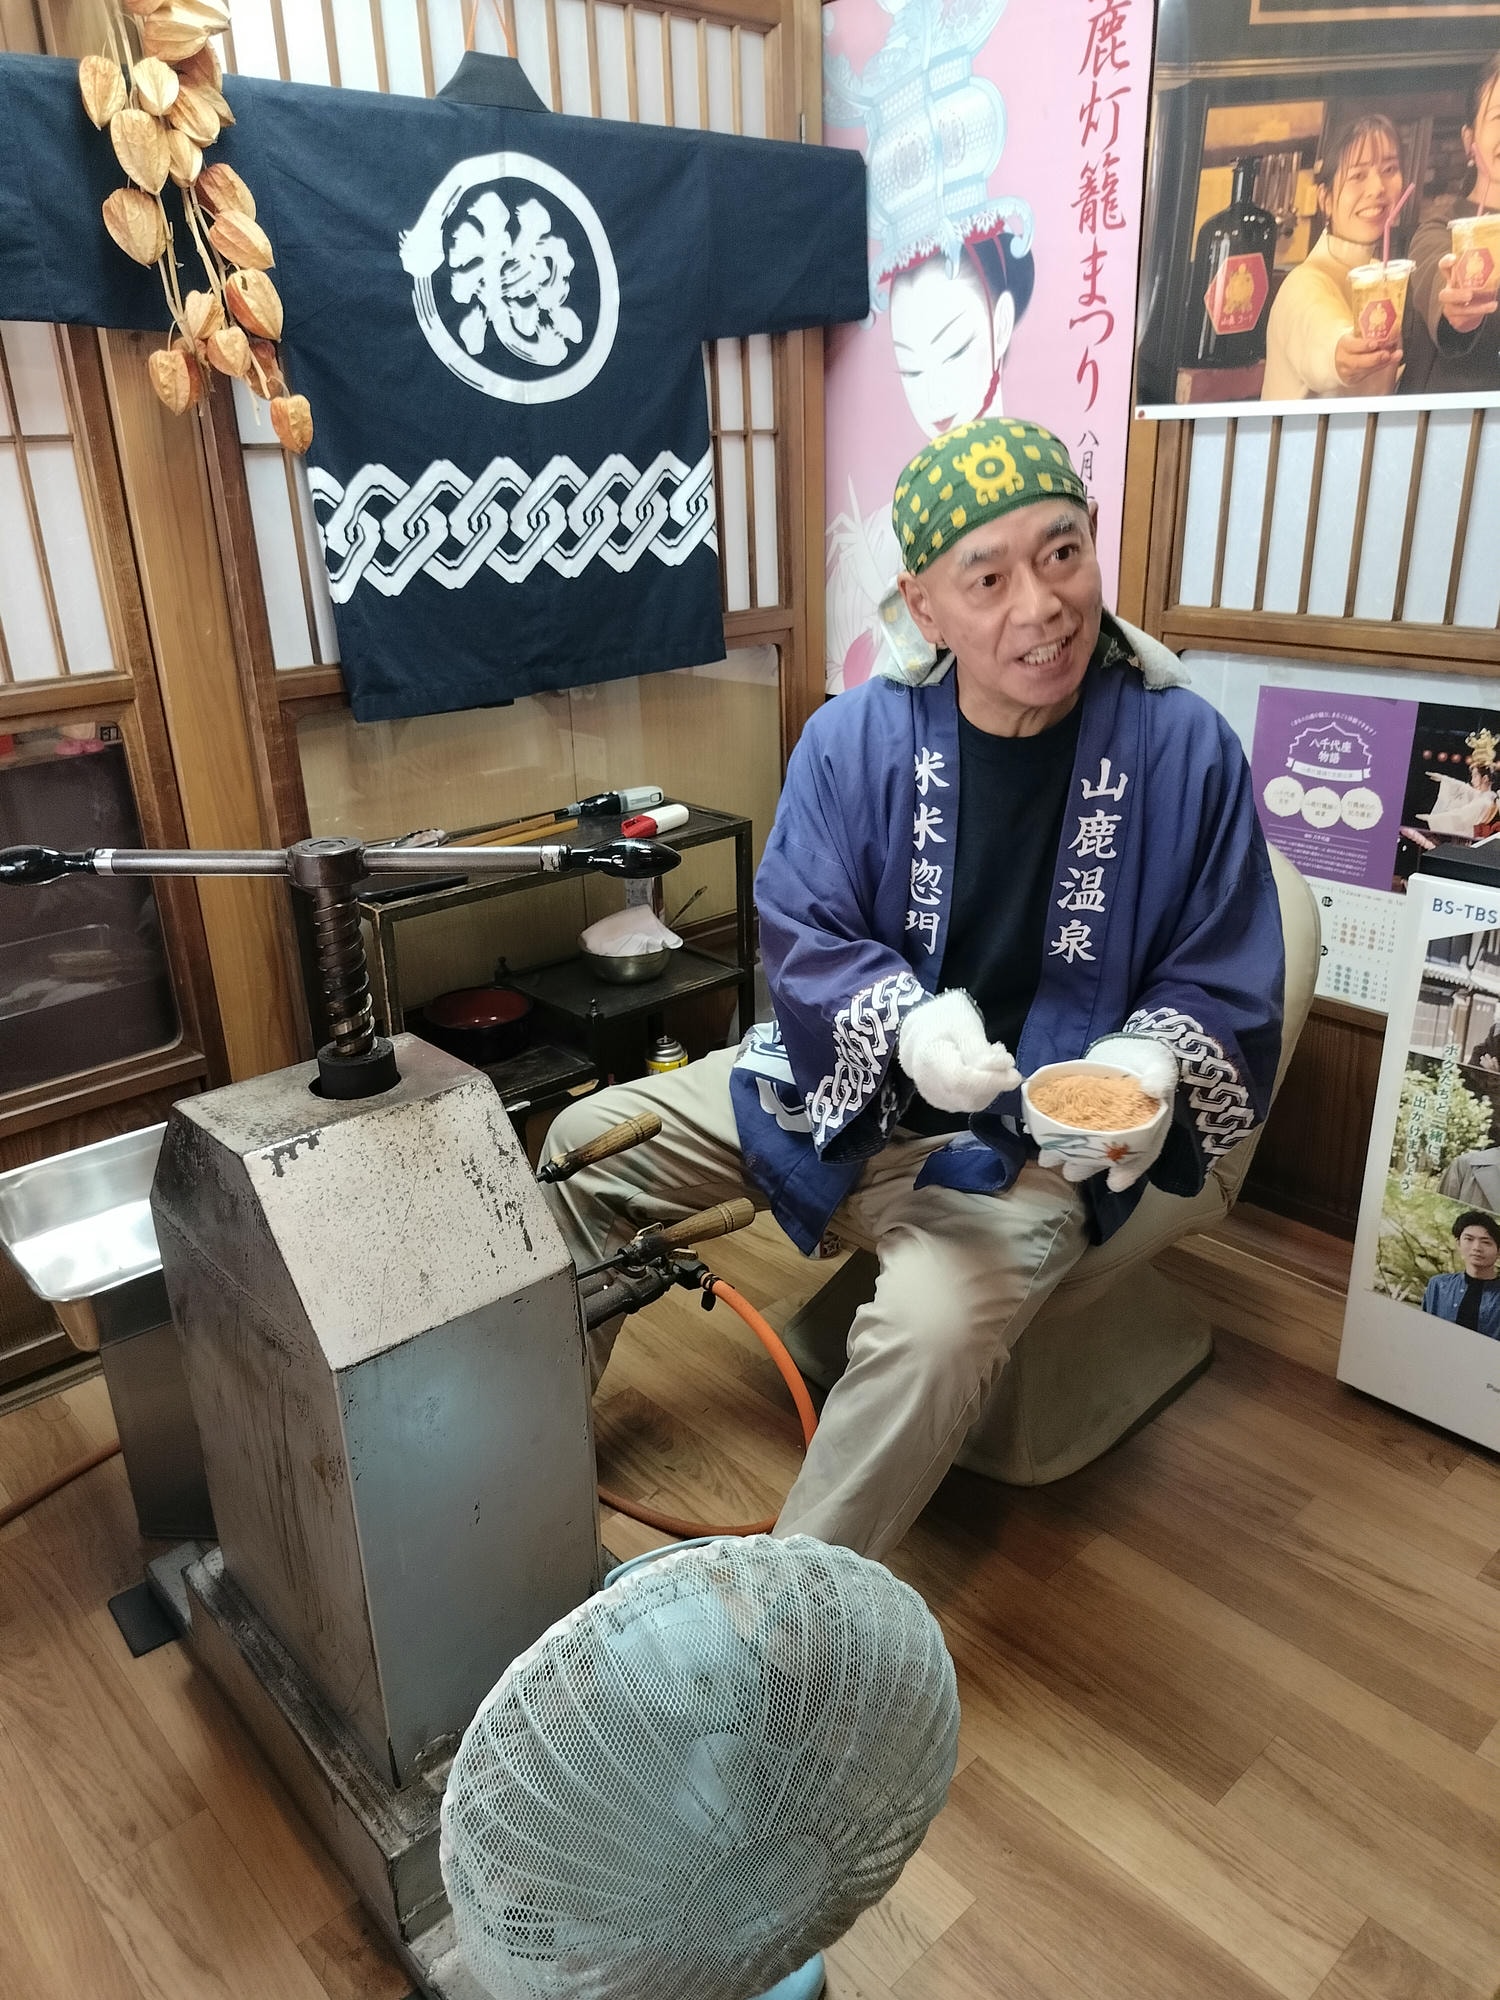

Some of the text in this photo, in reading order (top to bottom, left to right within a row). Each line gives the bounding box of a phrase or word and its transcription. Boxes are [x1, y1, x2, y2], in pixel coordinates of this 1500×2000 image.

[904, 746, 950, 955] 米米惣門
[1048, 757, 1129, 964] 山鹿温泉
[1432, 897, 1498, 924] BS-TBS
